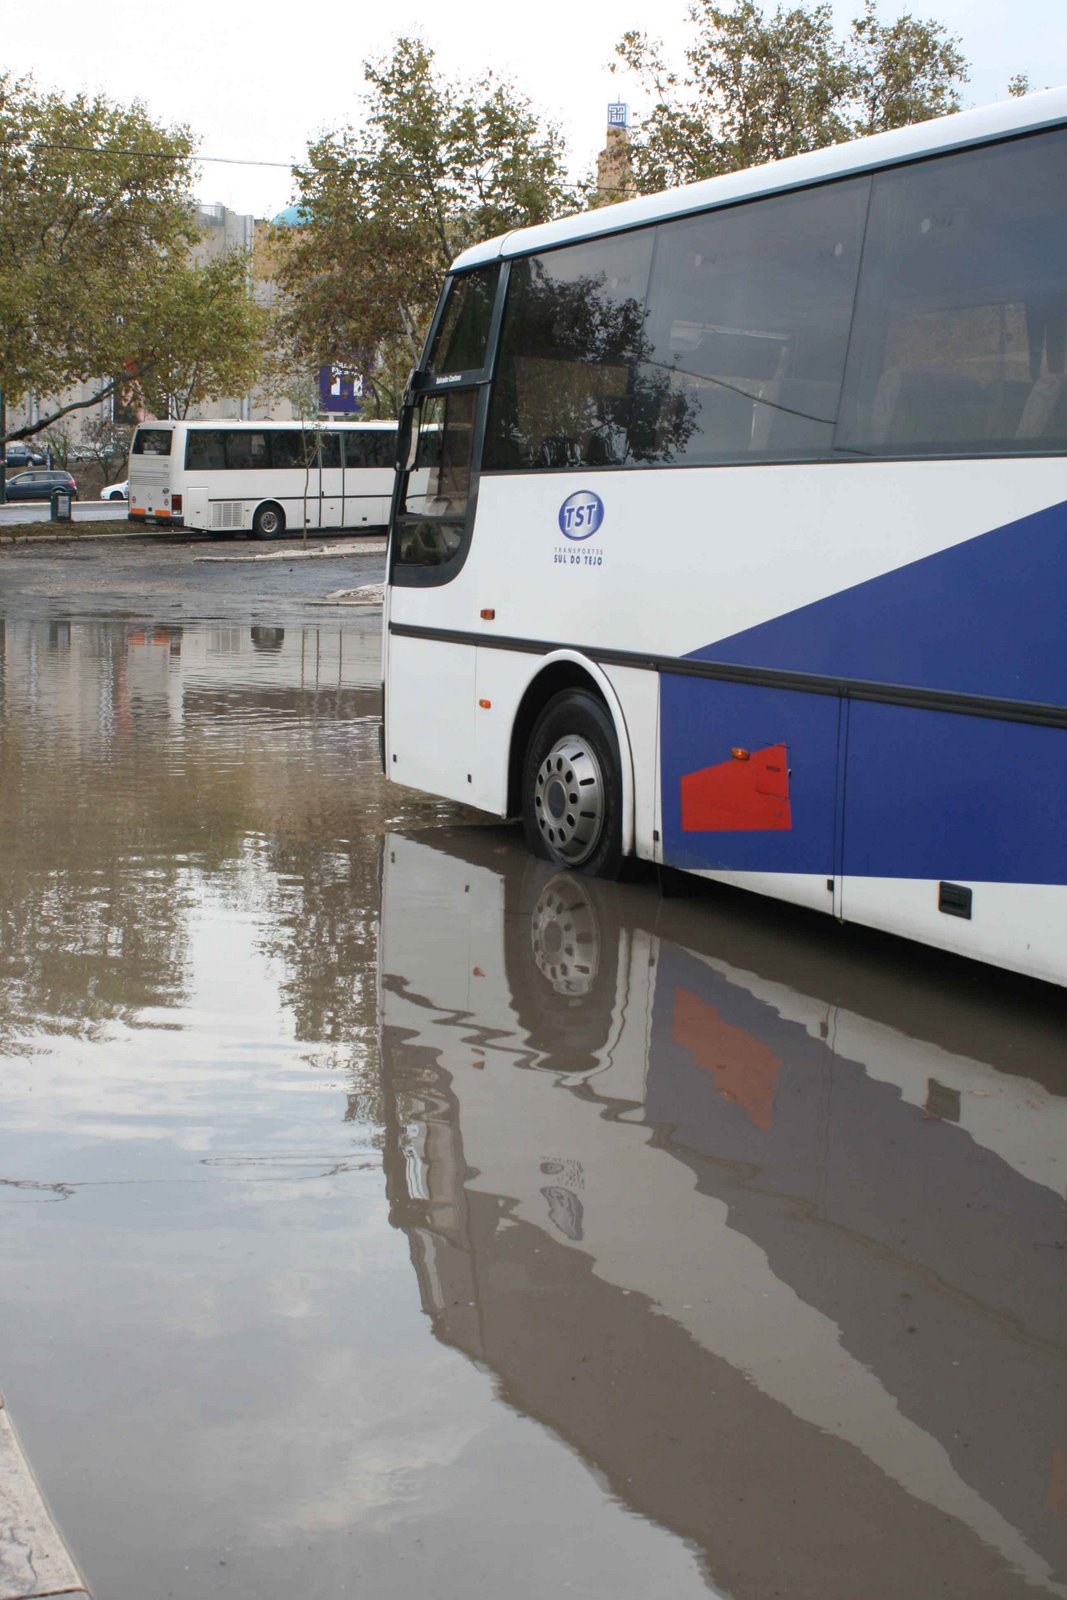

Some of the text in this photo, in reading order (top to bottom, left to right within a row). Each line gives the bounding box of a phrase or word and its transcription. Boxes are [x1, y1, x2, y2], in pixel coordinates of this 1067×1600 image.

[565, 503, 596, 529] TST
[554, 547, 603, 555] TRANSPORTES
[554, 554, 602, 565] SUL DO TEJO
